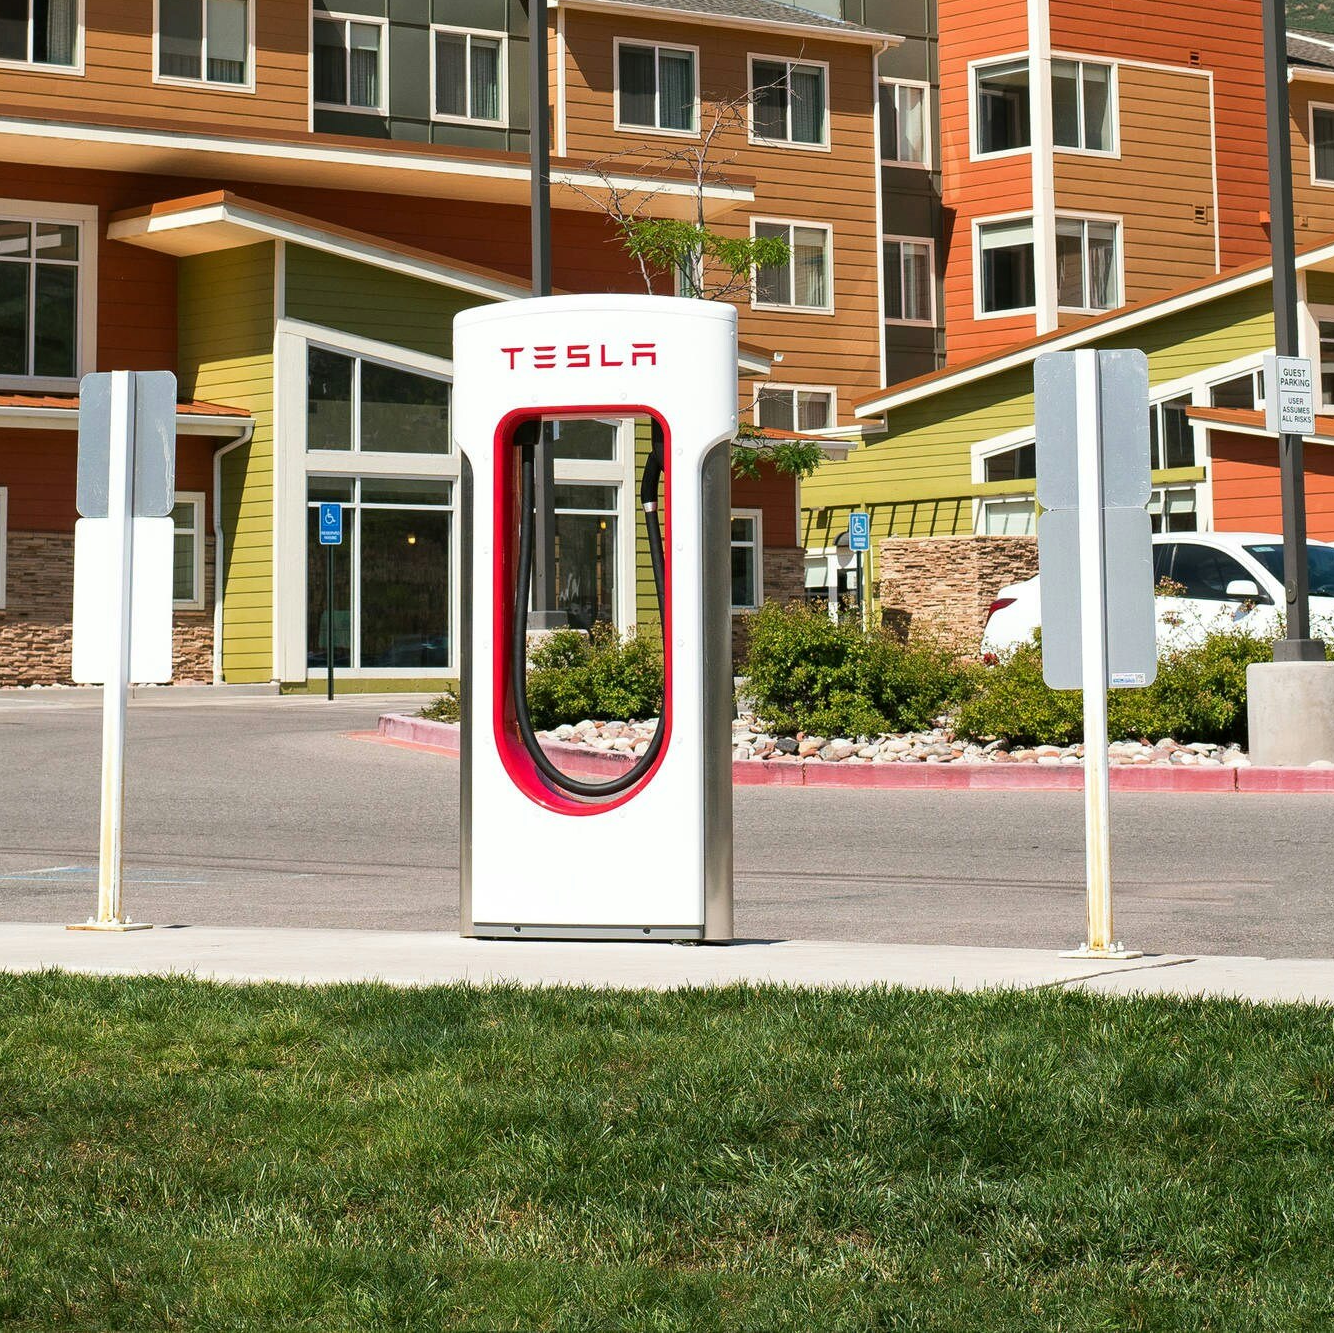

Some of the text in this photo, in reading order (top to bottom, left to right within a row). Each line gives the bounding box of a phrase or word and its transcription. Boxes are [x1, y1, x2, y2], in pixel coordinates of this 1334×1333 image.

[501, 342, 657, 370] TESLA
[1283, 368, 1306, 377] GUEST
[1280, 377, 1310, 387] PARKING
[1288, 397, 1304, 405] USER
[1283, 406, 1310, 414] ASSUMES
[1282, 415, 1312, 423] ALL RISKS
